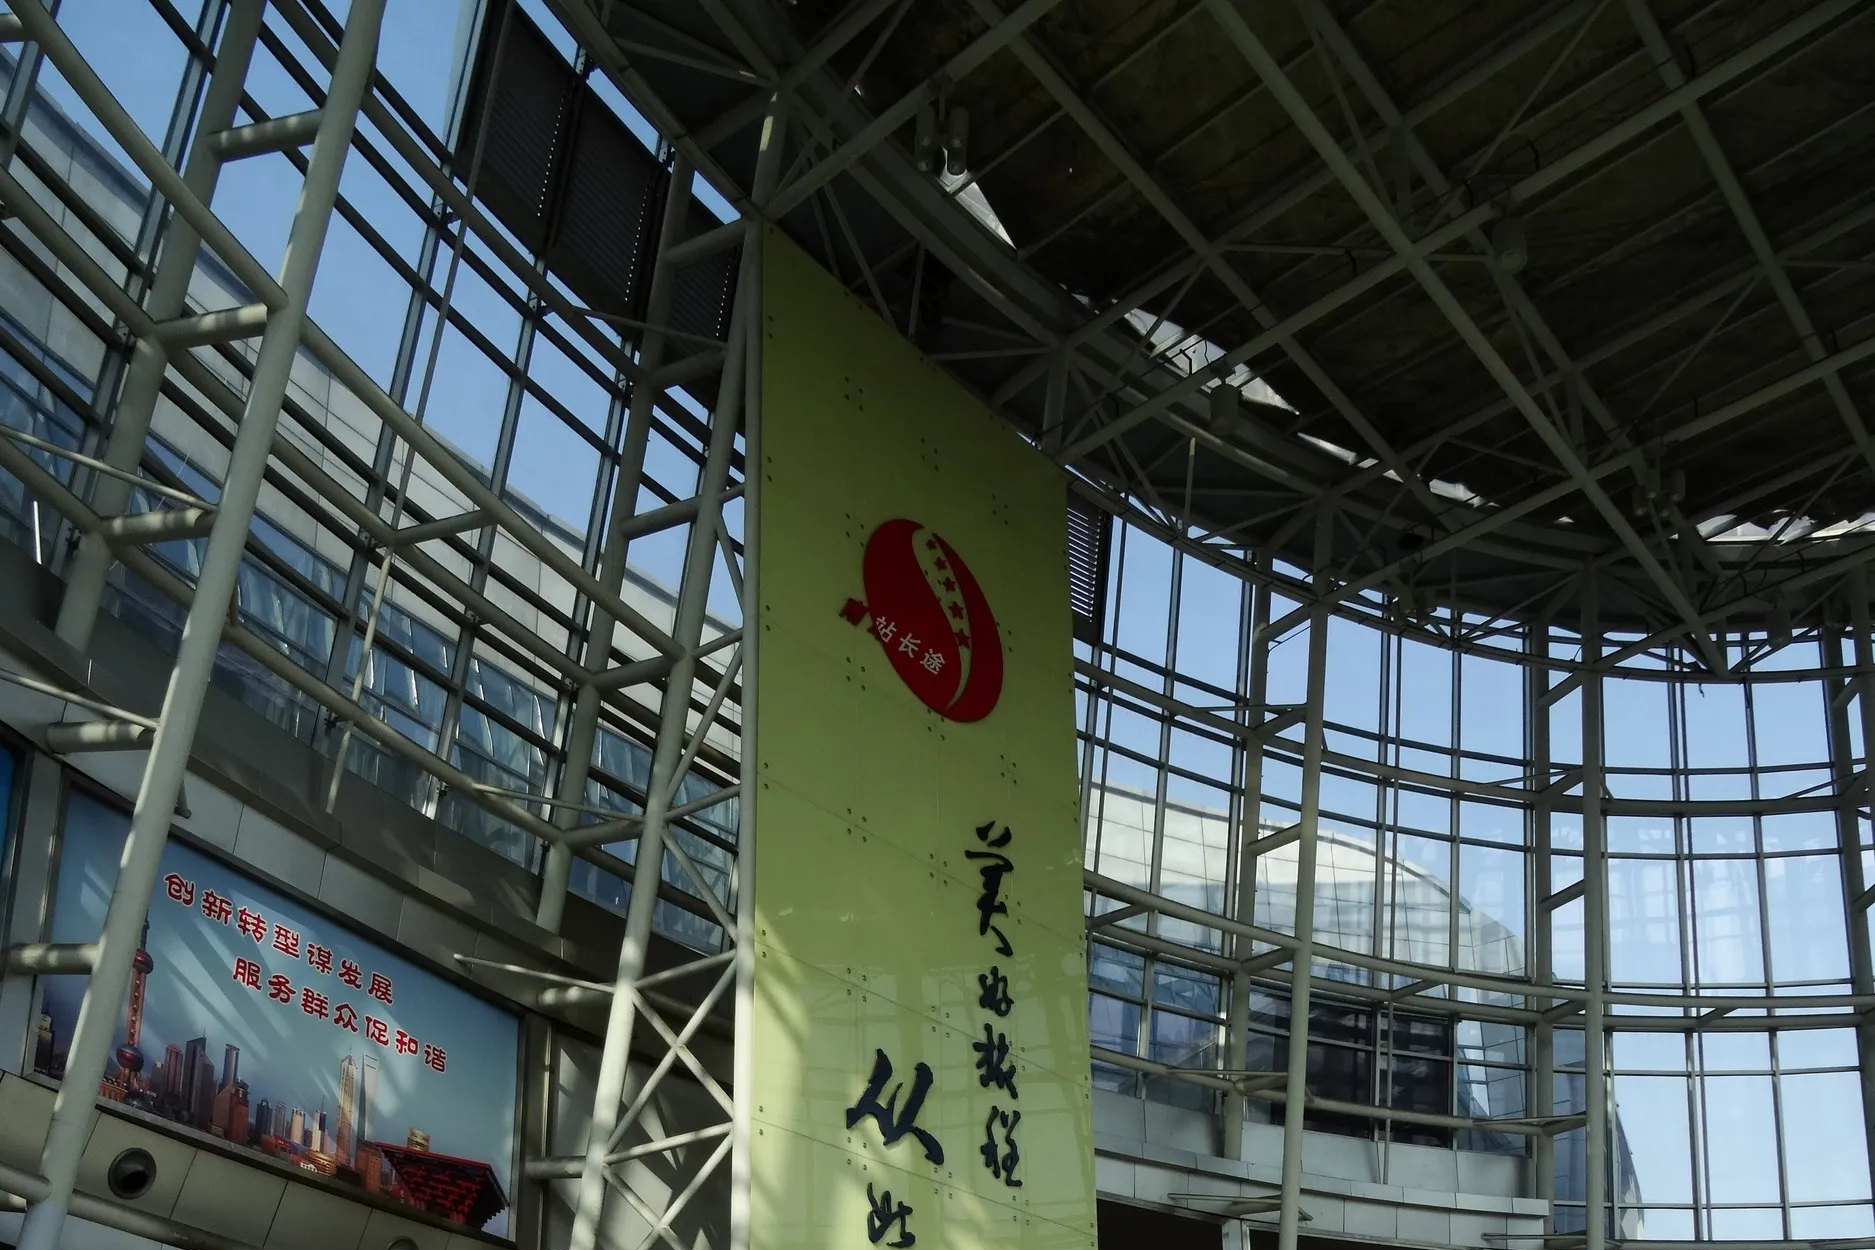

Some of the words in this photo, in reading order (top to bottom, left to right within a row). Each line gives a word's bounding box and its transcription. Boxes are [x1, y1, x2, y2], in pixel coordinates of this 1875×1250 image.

[163, 872, 395, 1006] 创新转型谋发展
[232, 956, 449, 1074] 服务群众促和谐
